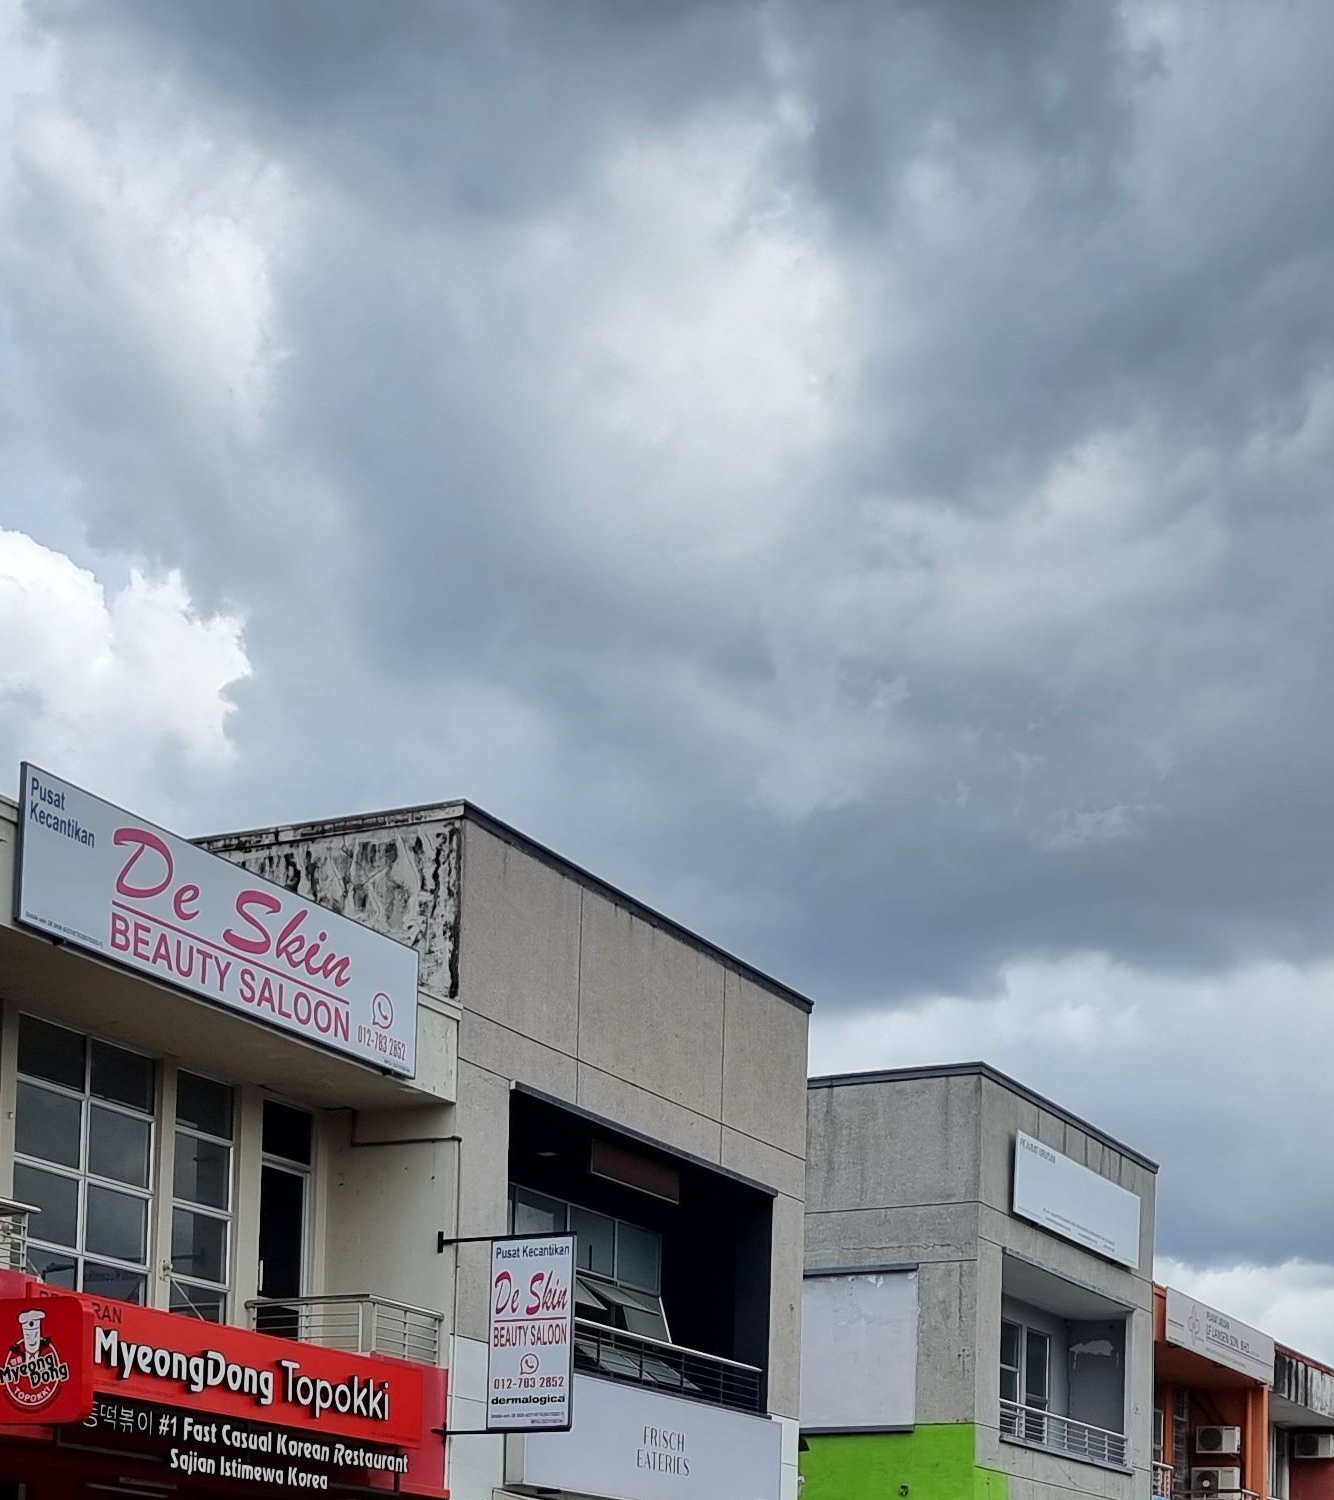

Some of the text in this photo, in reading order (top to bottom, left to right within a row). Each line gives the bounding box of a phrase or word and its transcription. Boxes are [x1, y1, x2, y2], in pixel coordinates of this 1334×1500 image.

[30, 776, 65, 811] Pusat
[29, 801, 95, 848] Kecantikan
[112, 827, 352, 987] De Skin
[110, 911, 232, 992] BEAUTY
[239, 968, 350, 1042] SALOON
[496, 1244, 570, 1260] Pusat Kecantikan
[494, 1270, 568, 1316] De Skin
[494, 1323, 568, 1348] BEAUTY SALOON
[31, 1364, 68, 1388] Dong
[94, 1328, 390, 1421] MyeongDong Topokki
[13, 1386, 51, 1402] TOPOKKI
[491, 1394, 566, 1406] dermalogica
[158, 1414, 409, 1474] #1 Fast Casual Korean Restaurant
[643, 1425, 686, 1453] FRISCH
[170, 1448, 329, 1490] Sajian Istimewa Korea
[636, 1449, 690, 1477] EATERIES
